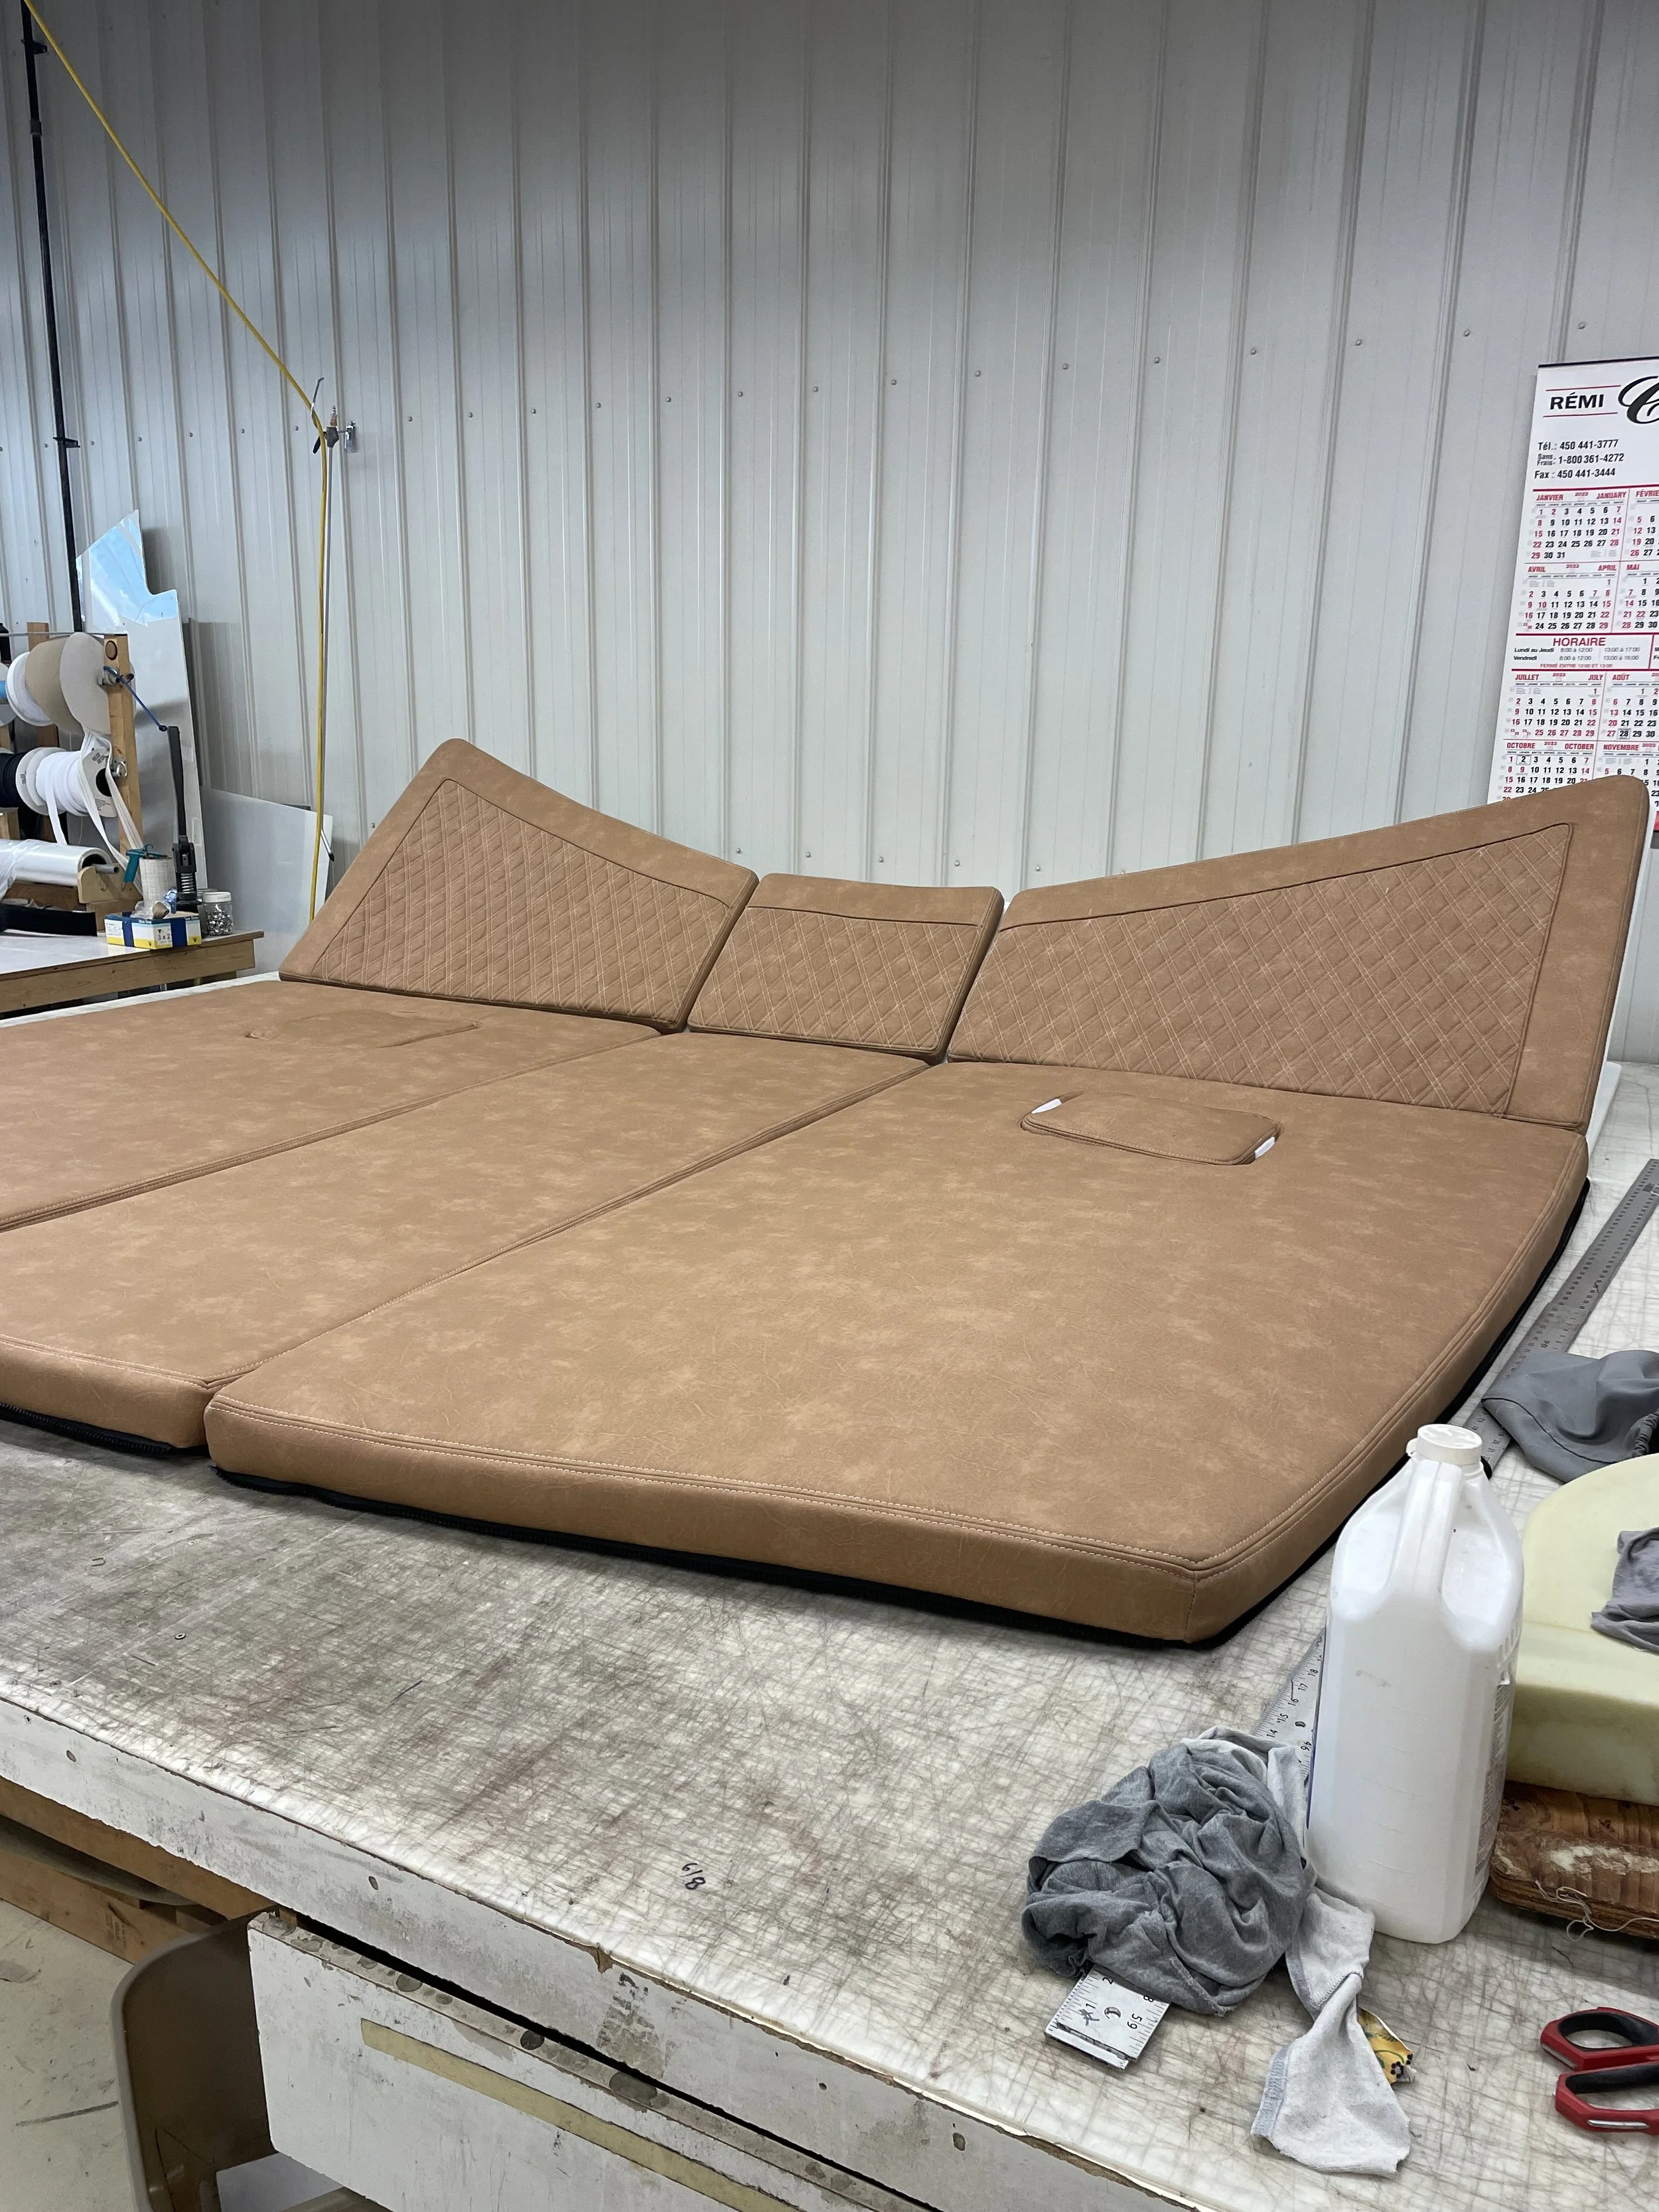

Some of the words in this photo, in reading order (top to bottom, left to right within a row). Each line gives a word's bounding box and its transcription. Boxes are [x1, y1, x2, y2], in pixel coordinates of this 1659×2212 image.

[1550, 392, 1605, 410] RÉMI
[1559, 441, 1575, 451] 450
[1578, 439, 1619, 449] 441-3777
[1559, 455, 1582, 465] 1-800
[1584, 453, 1624, 463] 361-4272
[1534, 471, 1550, 479] Fax
[1557, 470, 1573, 479] 450
[1575, 468, 1615, 478] 441-3444
[1553, 637, 1606, 646] HORAIRE
[1287, 1698, 1299, 1706] 16
[1278, 1713, 1289, 1723] 15
[1266, 1729, 1278, 1737] 14
